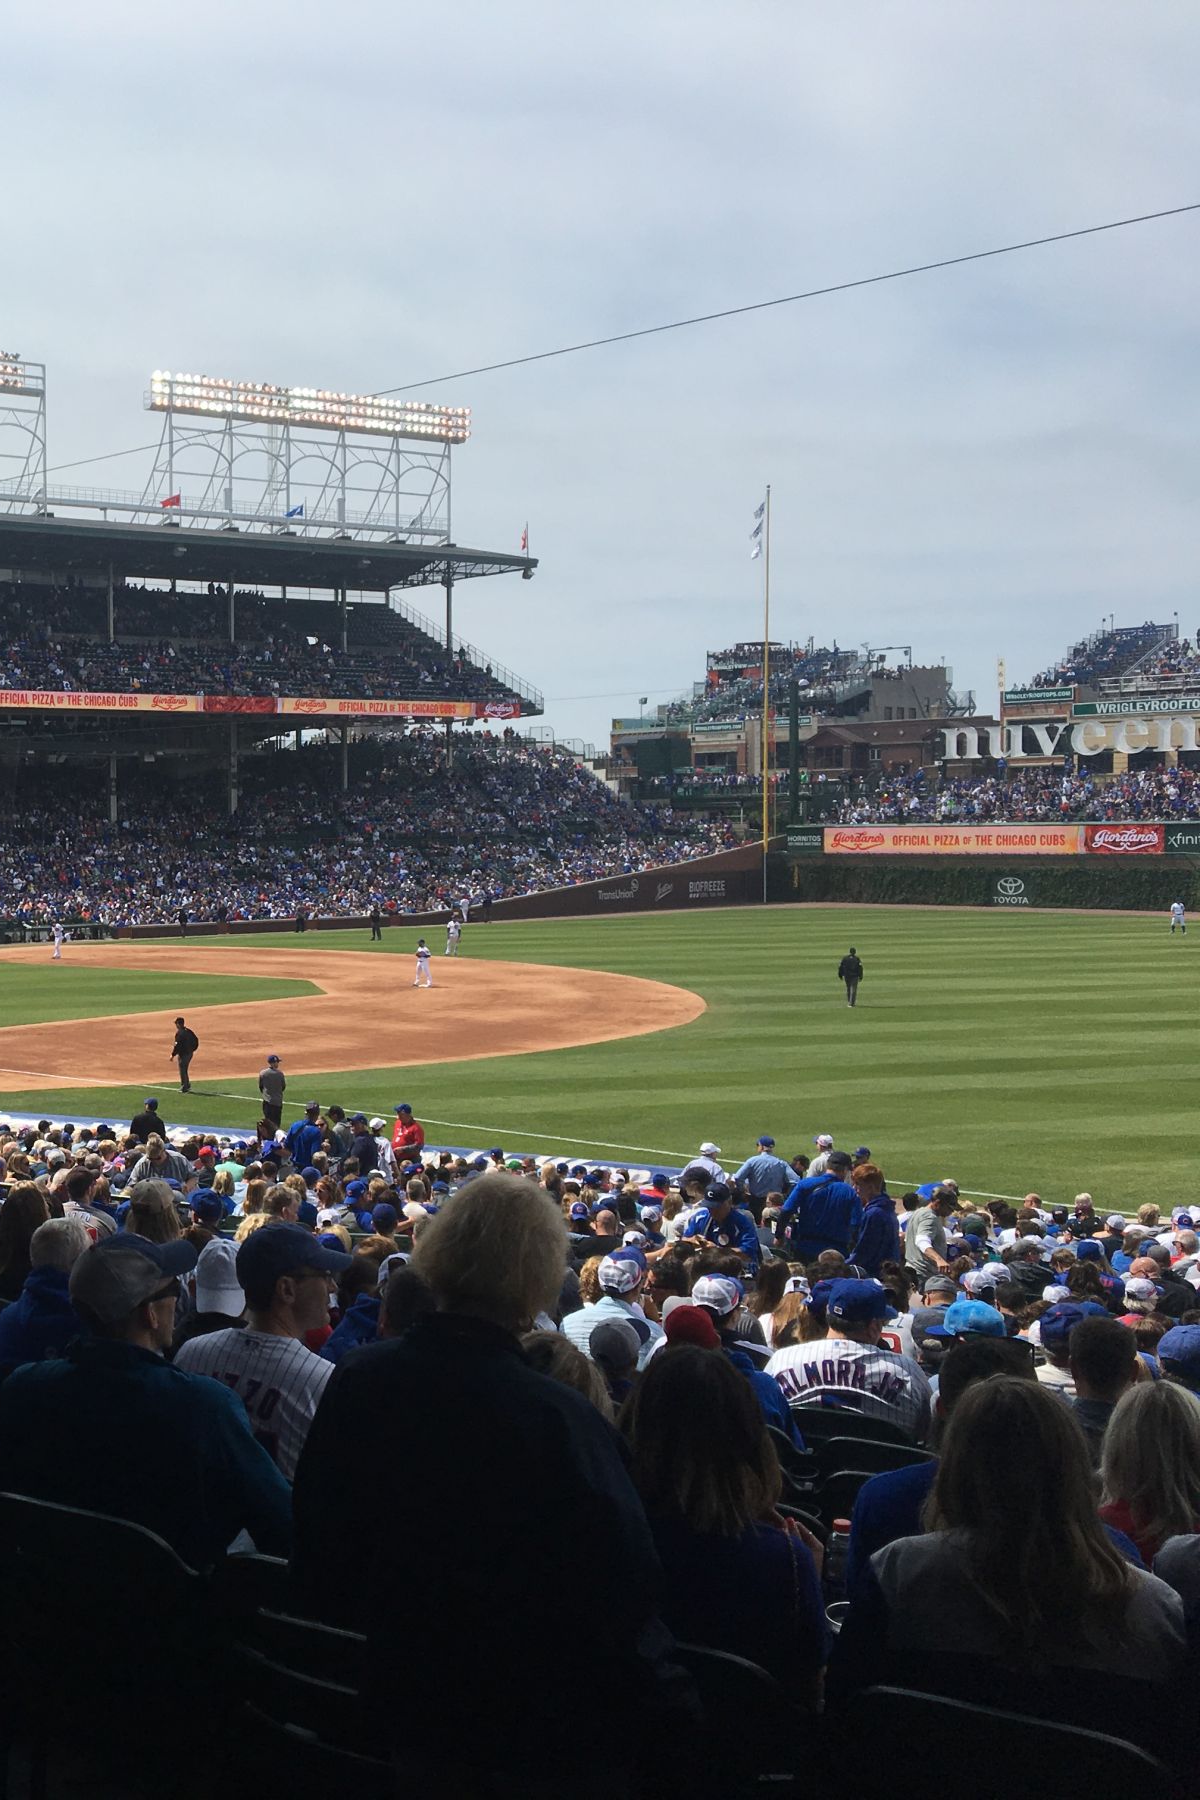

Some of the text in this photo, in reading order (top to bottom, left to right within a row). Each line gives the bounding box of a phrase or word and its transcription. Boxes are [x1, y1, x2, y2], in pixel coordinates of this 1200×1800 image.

[32, 693, 55, 706] PIZZA
[57, 696, 65, 705] OF
[67, 694, 82, 706] THE
[84, 695, 117, 707] CHICAGO
[119, 696, 138, 708] CUBS
[152, 695, 188, 710] Giordano's
[339, 701, 367, 712] OFFICIAL
[369, 702, 388, 713] PIZZA
[398, 703, 410, 713] THE
[411, 703, 438, 714] CHICAGO
[939, 715, 1200, 760] nuveen
[831, 832, 885, 850] Giordano's
[892, 834, 1065, 846] OFFICIAL PIZZA OF THE CHICAGO CUBS
[1092, 829, 1159, 850] Giordano's
[689, 880, 726, 892] BIOFREEZE
[598, 888, 635, 901] TransUnion
[993, 896, 1029, 904] TOYOTA
[774, 1359, 867, 1399] ALMORA
